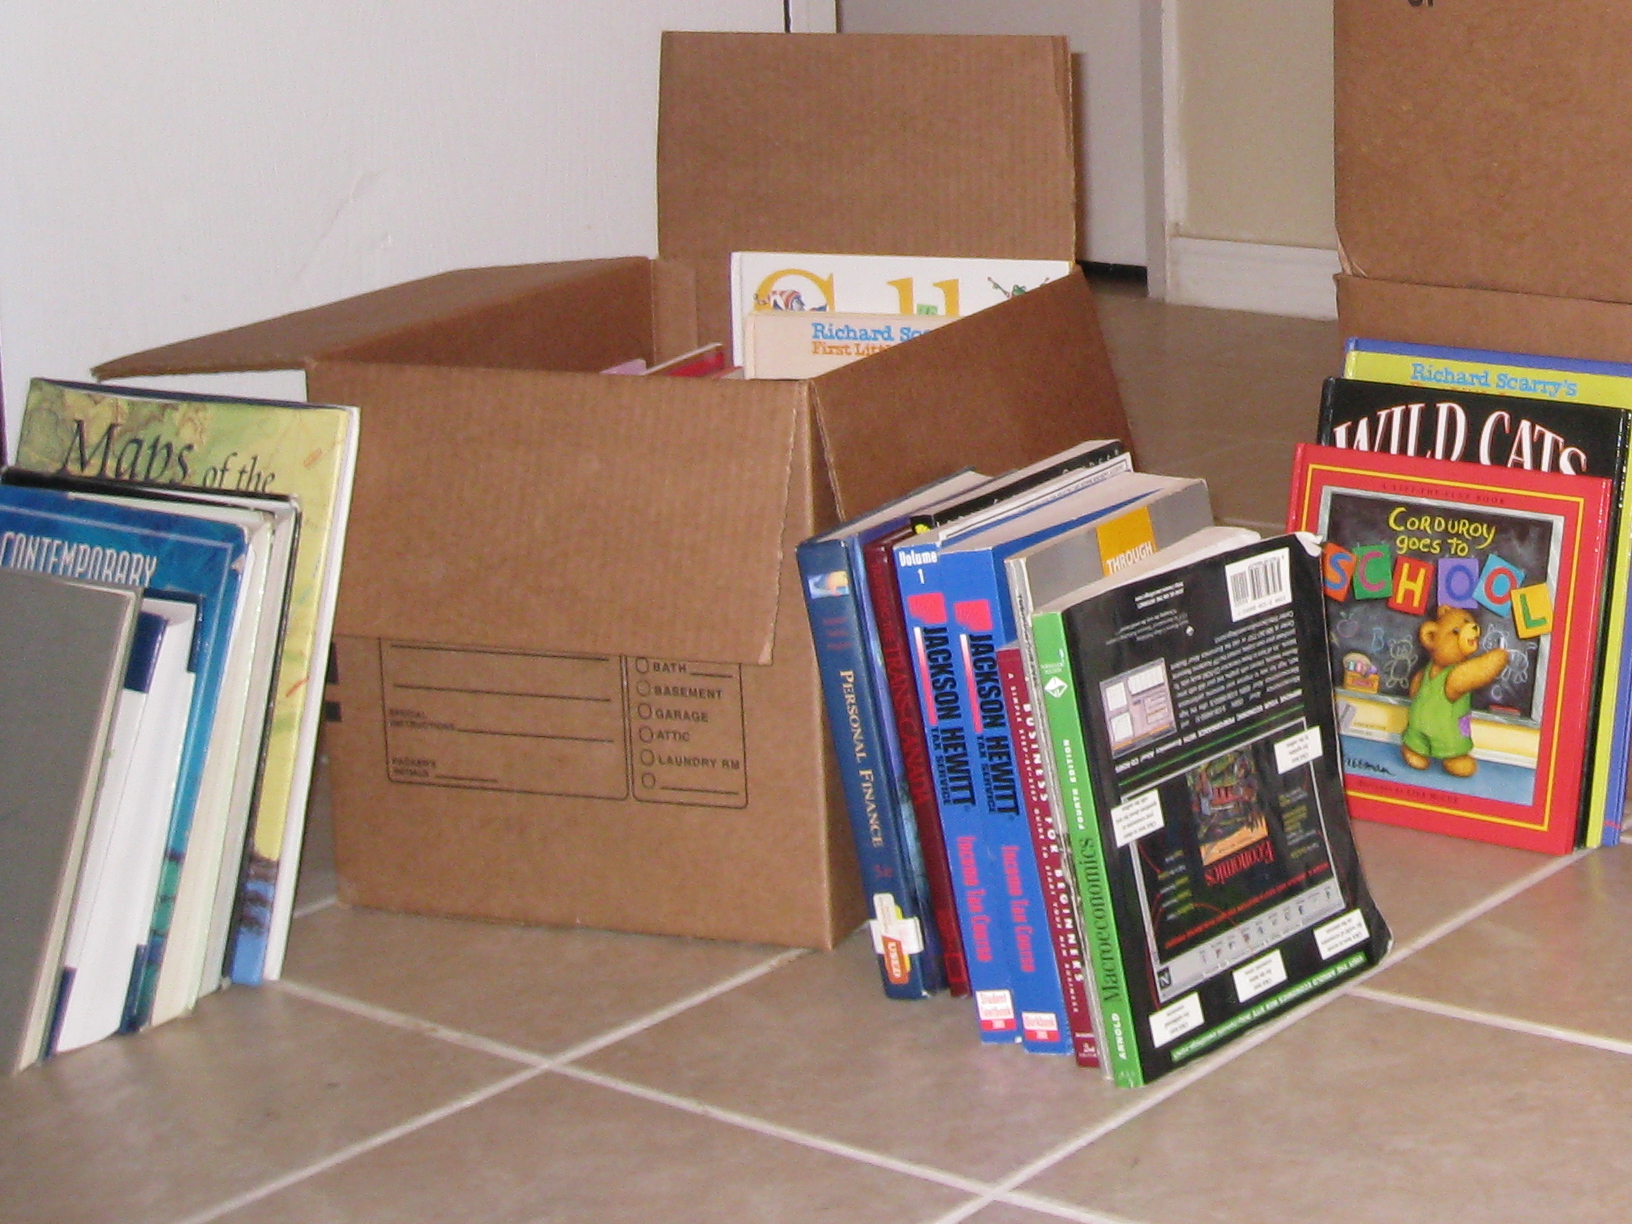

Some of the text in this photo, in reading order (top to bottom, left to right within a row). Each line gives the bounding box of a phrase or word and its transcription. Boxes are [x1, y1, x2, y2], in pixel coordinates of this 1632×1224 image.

[811, 322, 893, 342] Richard
[1410, 362, 1579, 398] Richard Scarry's
[60, 418, 277, 493] Maps of the
[1332, 401, 1589, 478] WILD CATS
[1388, 506, 1497, 550] CORDUROY
[1396, 534, 1469, 557] goes to
[1, 531, 157, 588] CONTEMPORARY
[899, 550, 938, 567] Volume
[1106, 540, 1154, 576] THROUGH
[1323, 542, 1554, 639] SCHOOL
[652, 661, 687, 675] BATH
[653, 684, 724, 701] BASEMENT
[654, 707, 710, 724] GARAGE
[656, 729, 692, 743] ATTIC
[923, 626, 977, 806] JACKSON HEWITT
[969, 633, 1019, 815] JACKSON HEWITT
[657, 753, 741, 771] LAUNDRY RM
[838, 668, 884, 848] PERSONAL FINANCE
[1062, 739, 1085, 830] FOURTH EDITION
[1022, 702, 1086, 983] BUSINESS FOR BEGINNERS
[1079, 837, 1120, 1003] Macroeconomics
[1110, 1012, 1128, 1060] ARNOLD
